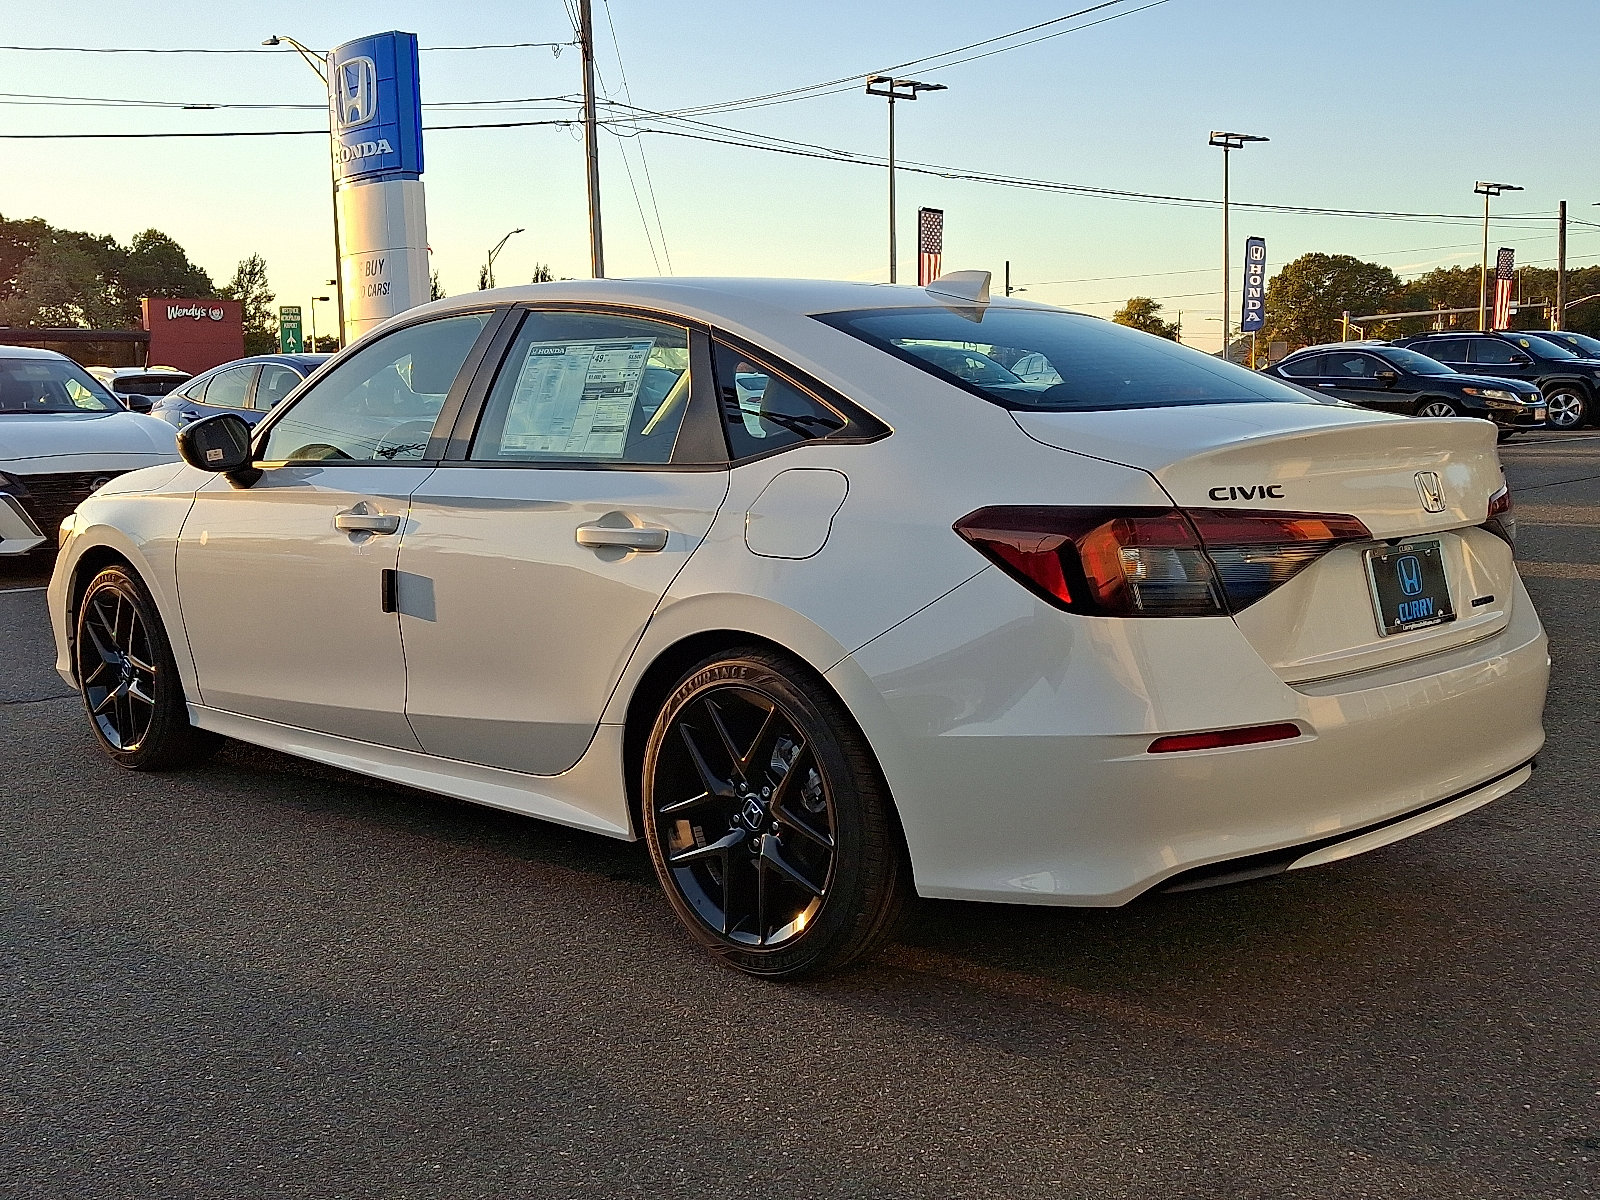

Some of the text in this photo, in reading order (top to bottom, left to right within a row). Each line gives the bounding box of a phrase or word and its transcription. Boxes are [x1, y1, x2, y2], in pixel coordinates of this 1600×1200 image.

[365, 258, 385, 277] BUY
[367, 281, 391, 298] CARS!
[1246, 264, 1263, 322] HONDA
[167, 304, 207, 321] Wendy's
[1208, 484, 1285, 501] CIVIC
[1398, 596, 1434, 623] CURRY
